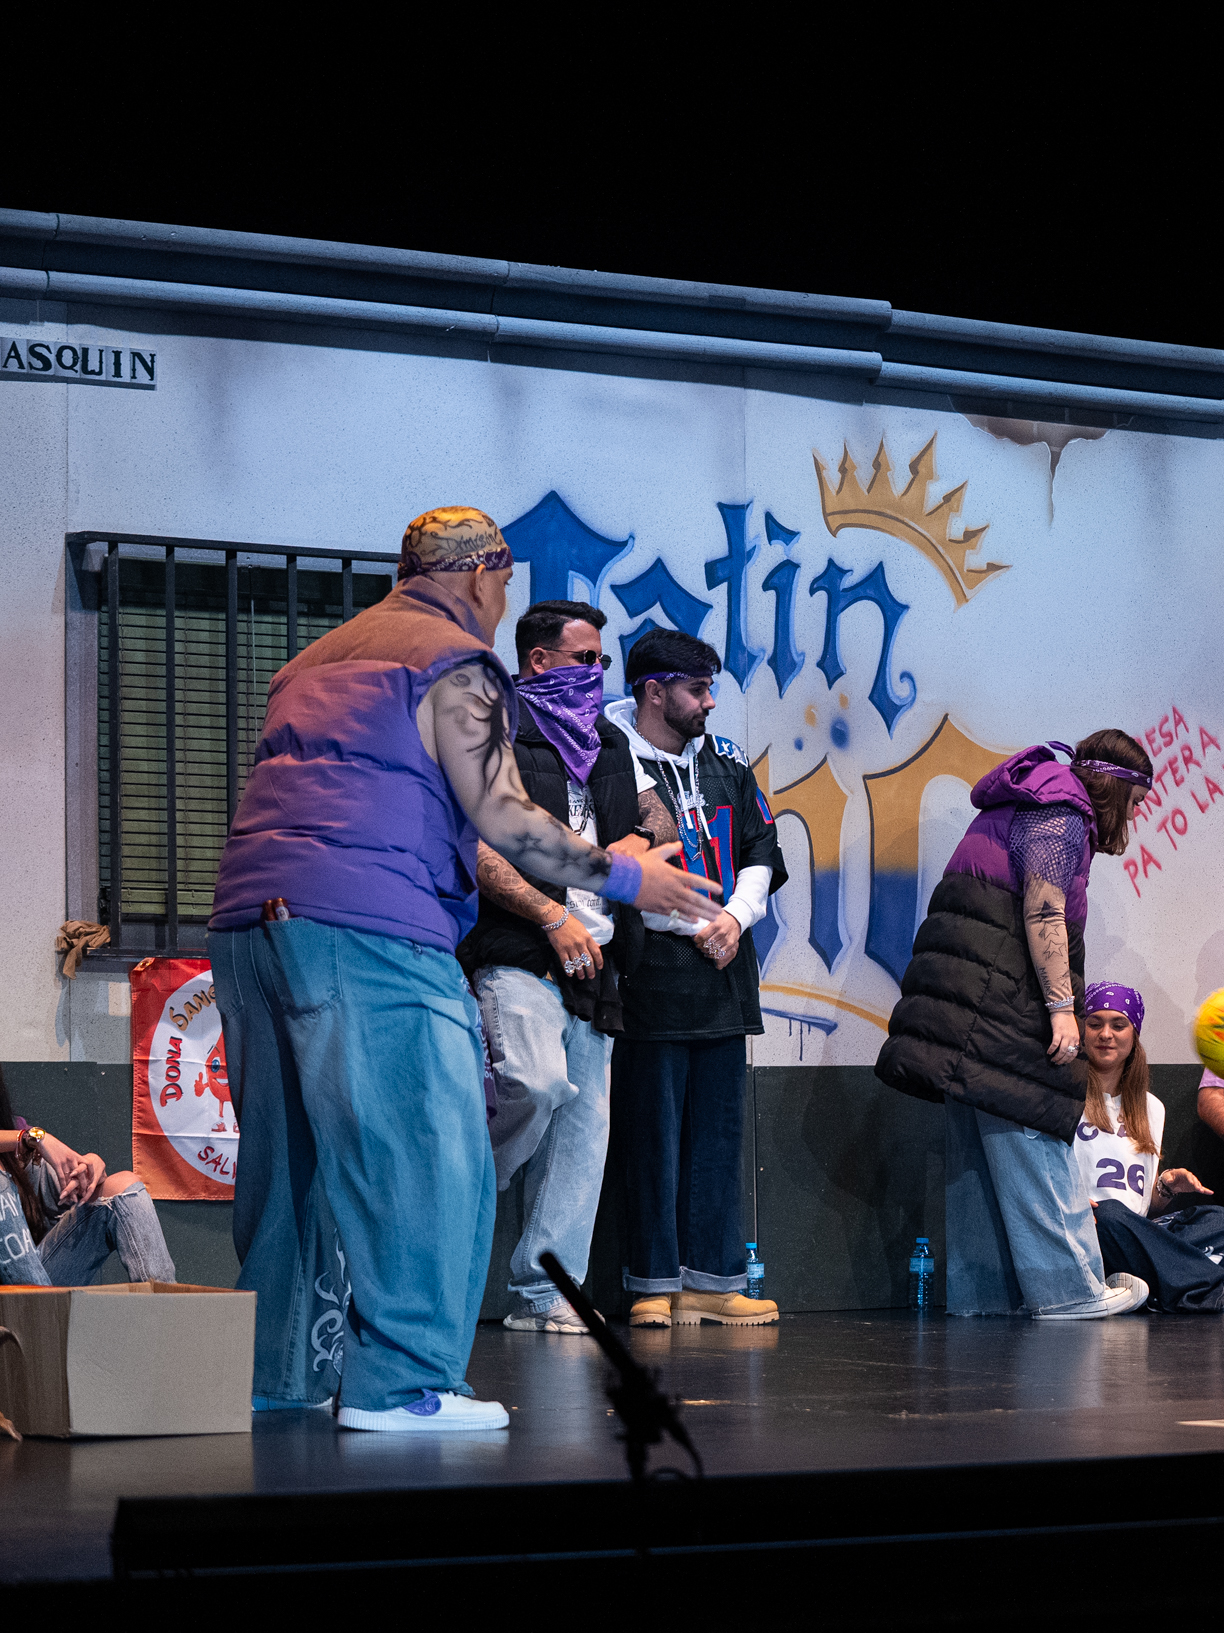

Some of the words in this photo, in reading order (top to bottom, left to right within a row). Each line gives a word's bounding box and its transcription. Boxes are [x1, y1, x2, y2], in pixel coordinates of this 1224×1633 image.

[2, 340, 157, 381] ASQUIN
[1136, 705, 1190, 758] ESA
[1123, 845, 1163, 899] PA
[1156, 807, 1189, 851] TO
[1190, 765, 1224, 814] LA
[160, 1035, 184, 1108] DONA
